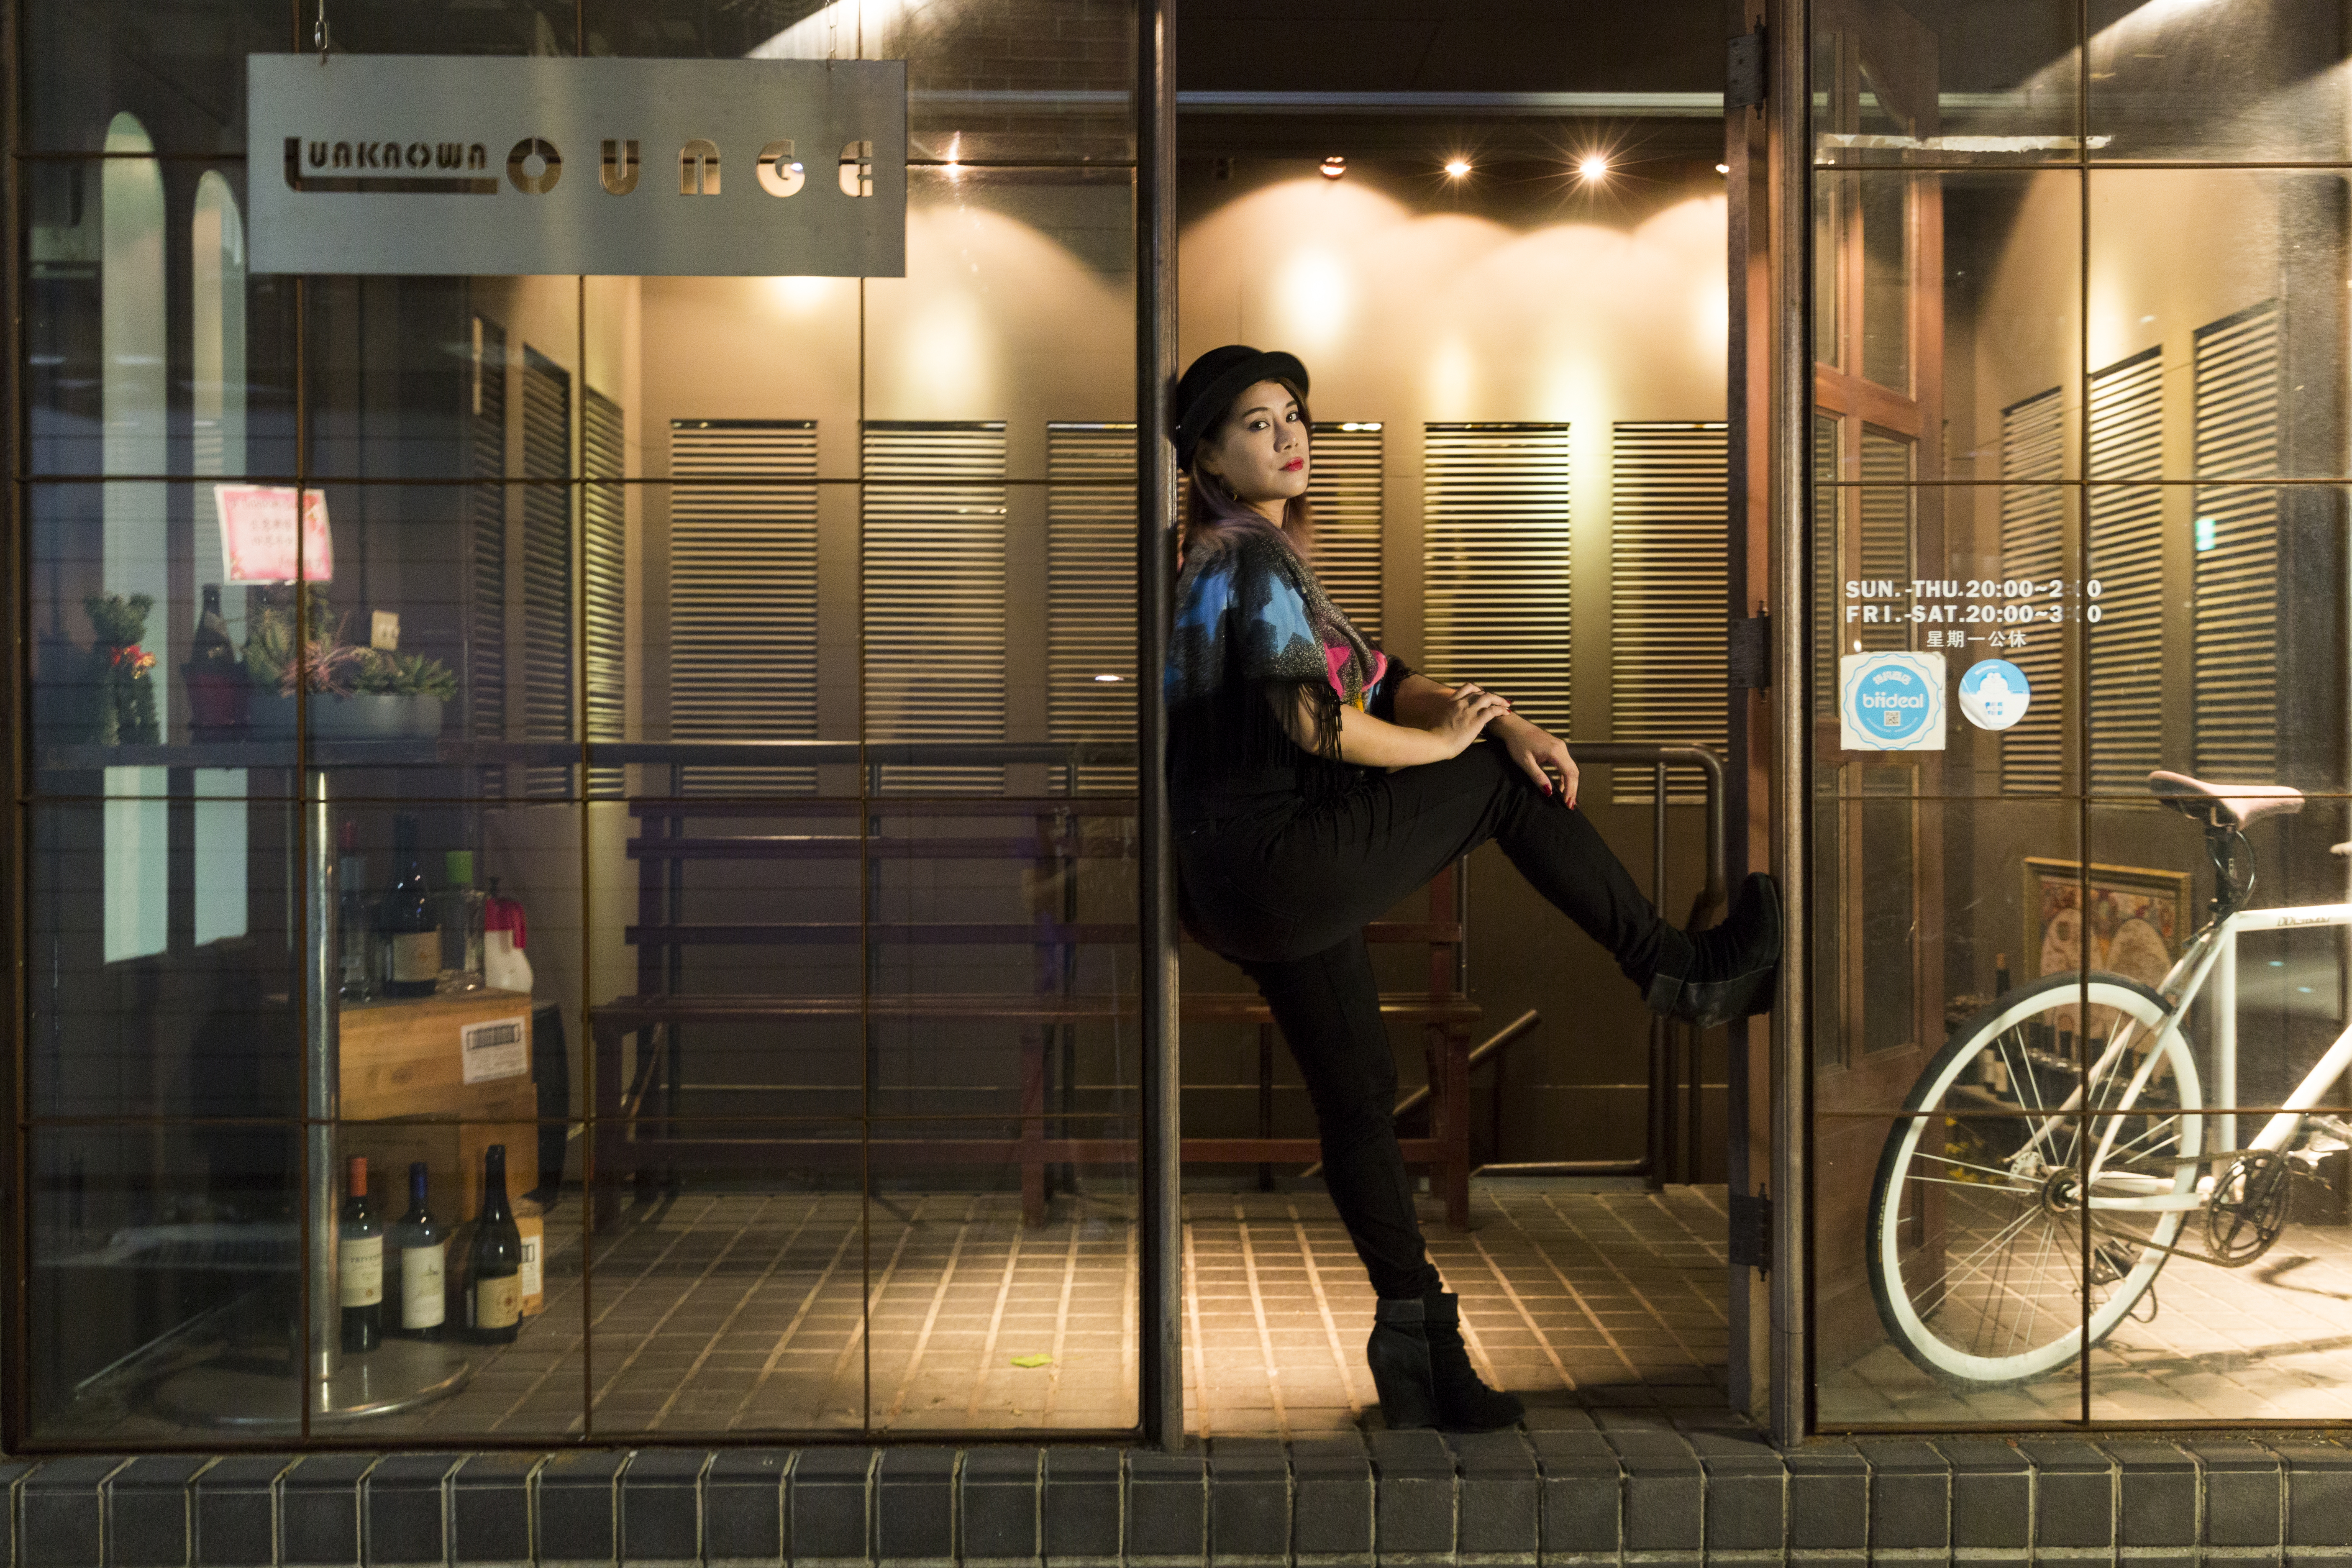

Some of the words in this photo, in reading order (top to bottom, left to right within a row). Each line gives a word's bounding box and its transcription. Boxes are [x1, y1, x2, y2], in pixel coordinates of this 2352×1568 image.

[1927, 630, 2027, 648] 星期一公休
